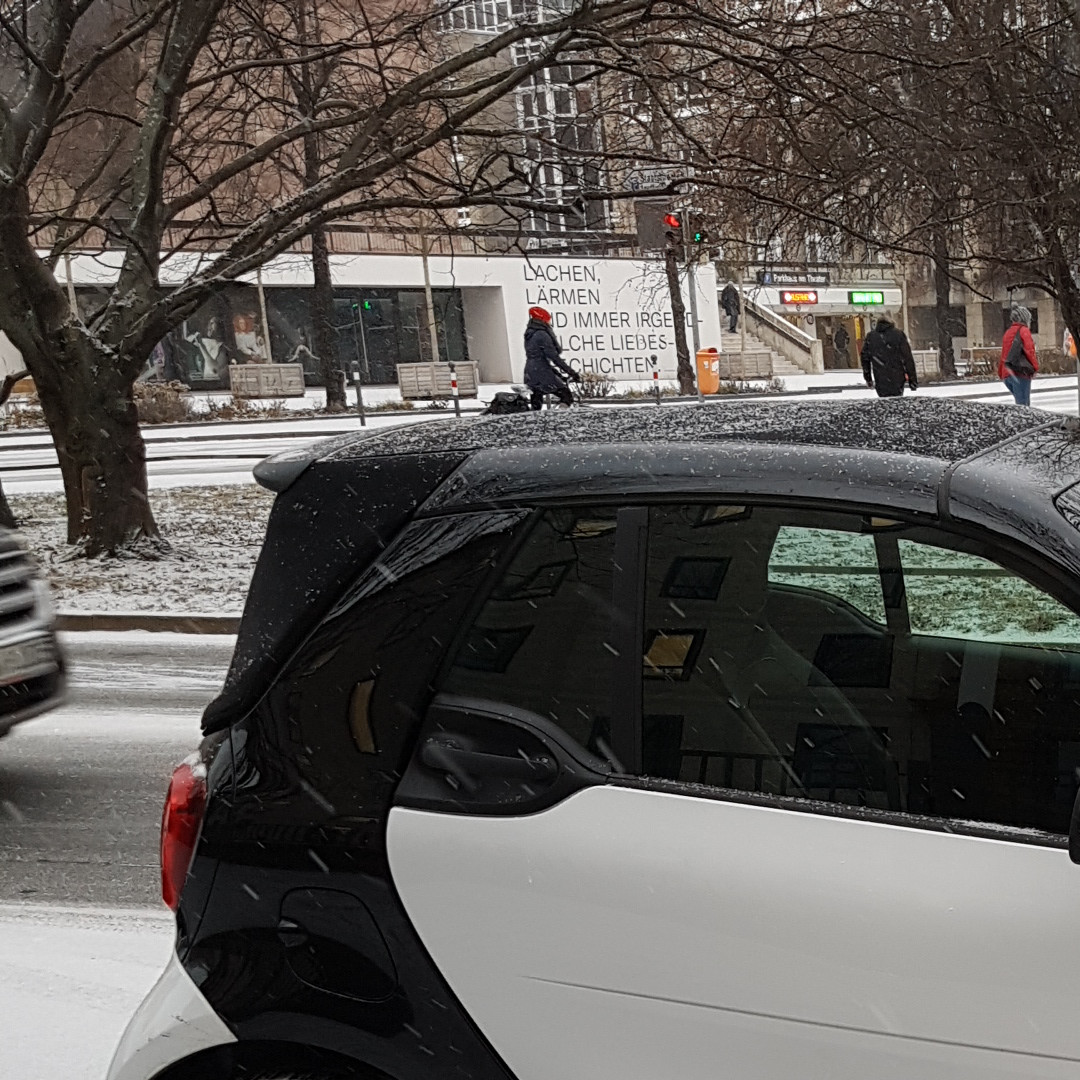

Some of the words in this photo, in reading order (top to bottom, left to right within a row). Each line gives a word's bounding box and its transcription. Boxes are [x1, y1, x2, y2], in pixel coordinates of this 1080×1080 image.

[523, 264, 601, 284] LACHEN,
[526, 285, 601, 305] LÄRMEN
[573, 311, 631, 328] IMMER
[610, 334, 675, 351] LIEBES-
